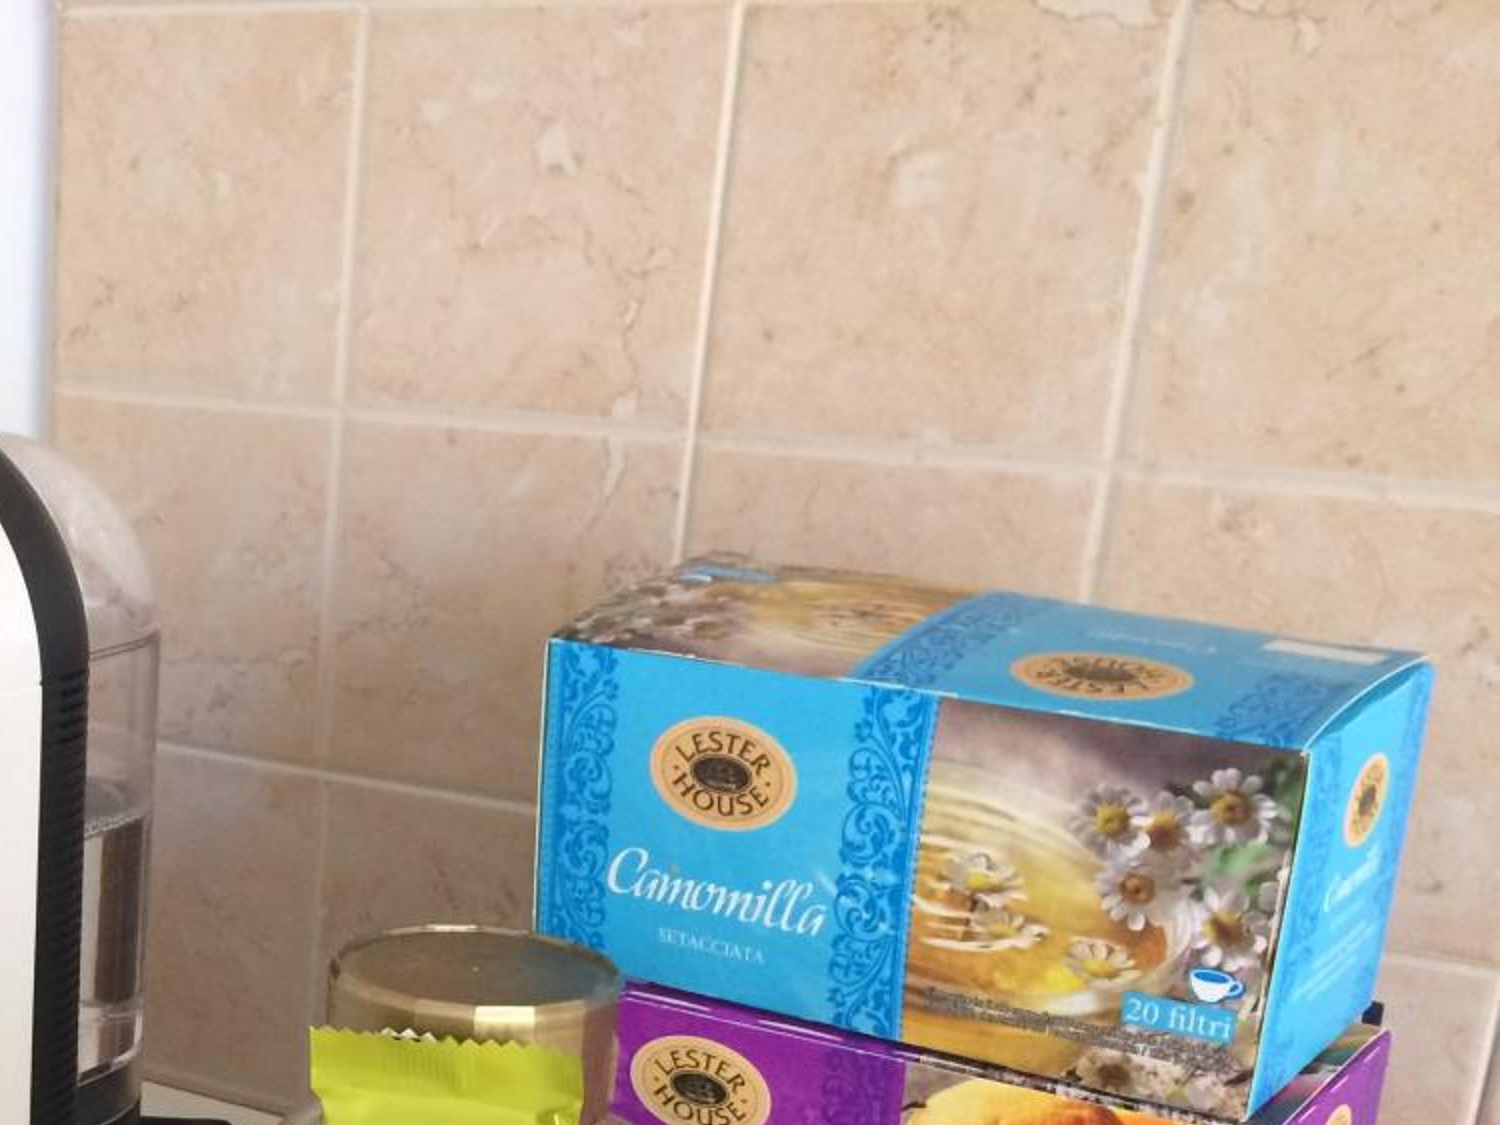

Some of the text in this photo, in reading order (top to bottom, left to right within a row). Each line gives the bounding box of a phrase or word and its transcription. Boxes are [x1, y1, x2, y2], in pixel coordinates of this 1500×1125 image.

[675, 731, 771, 777] LESTER
[672, 772, 770, 817] HOUSE
[607, 847, 829, 938] Camomilla
[657, 927, 766, 965] SETACCIATA
[1125, 999, 1232, 1040] 20 filtri
[654, 1049, 746, 1094] LESTER
